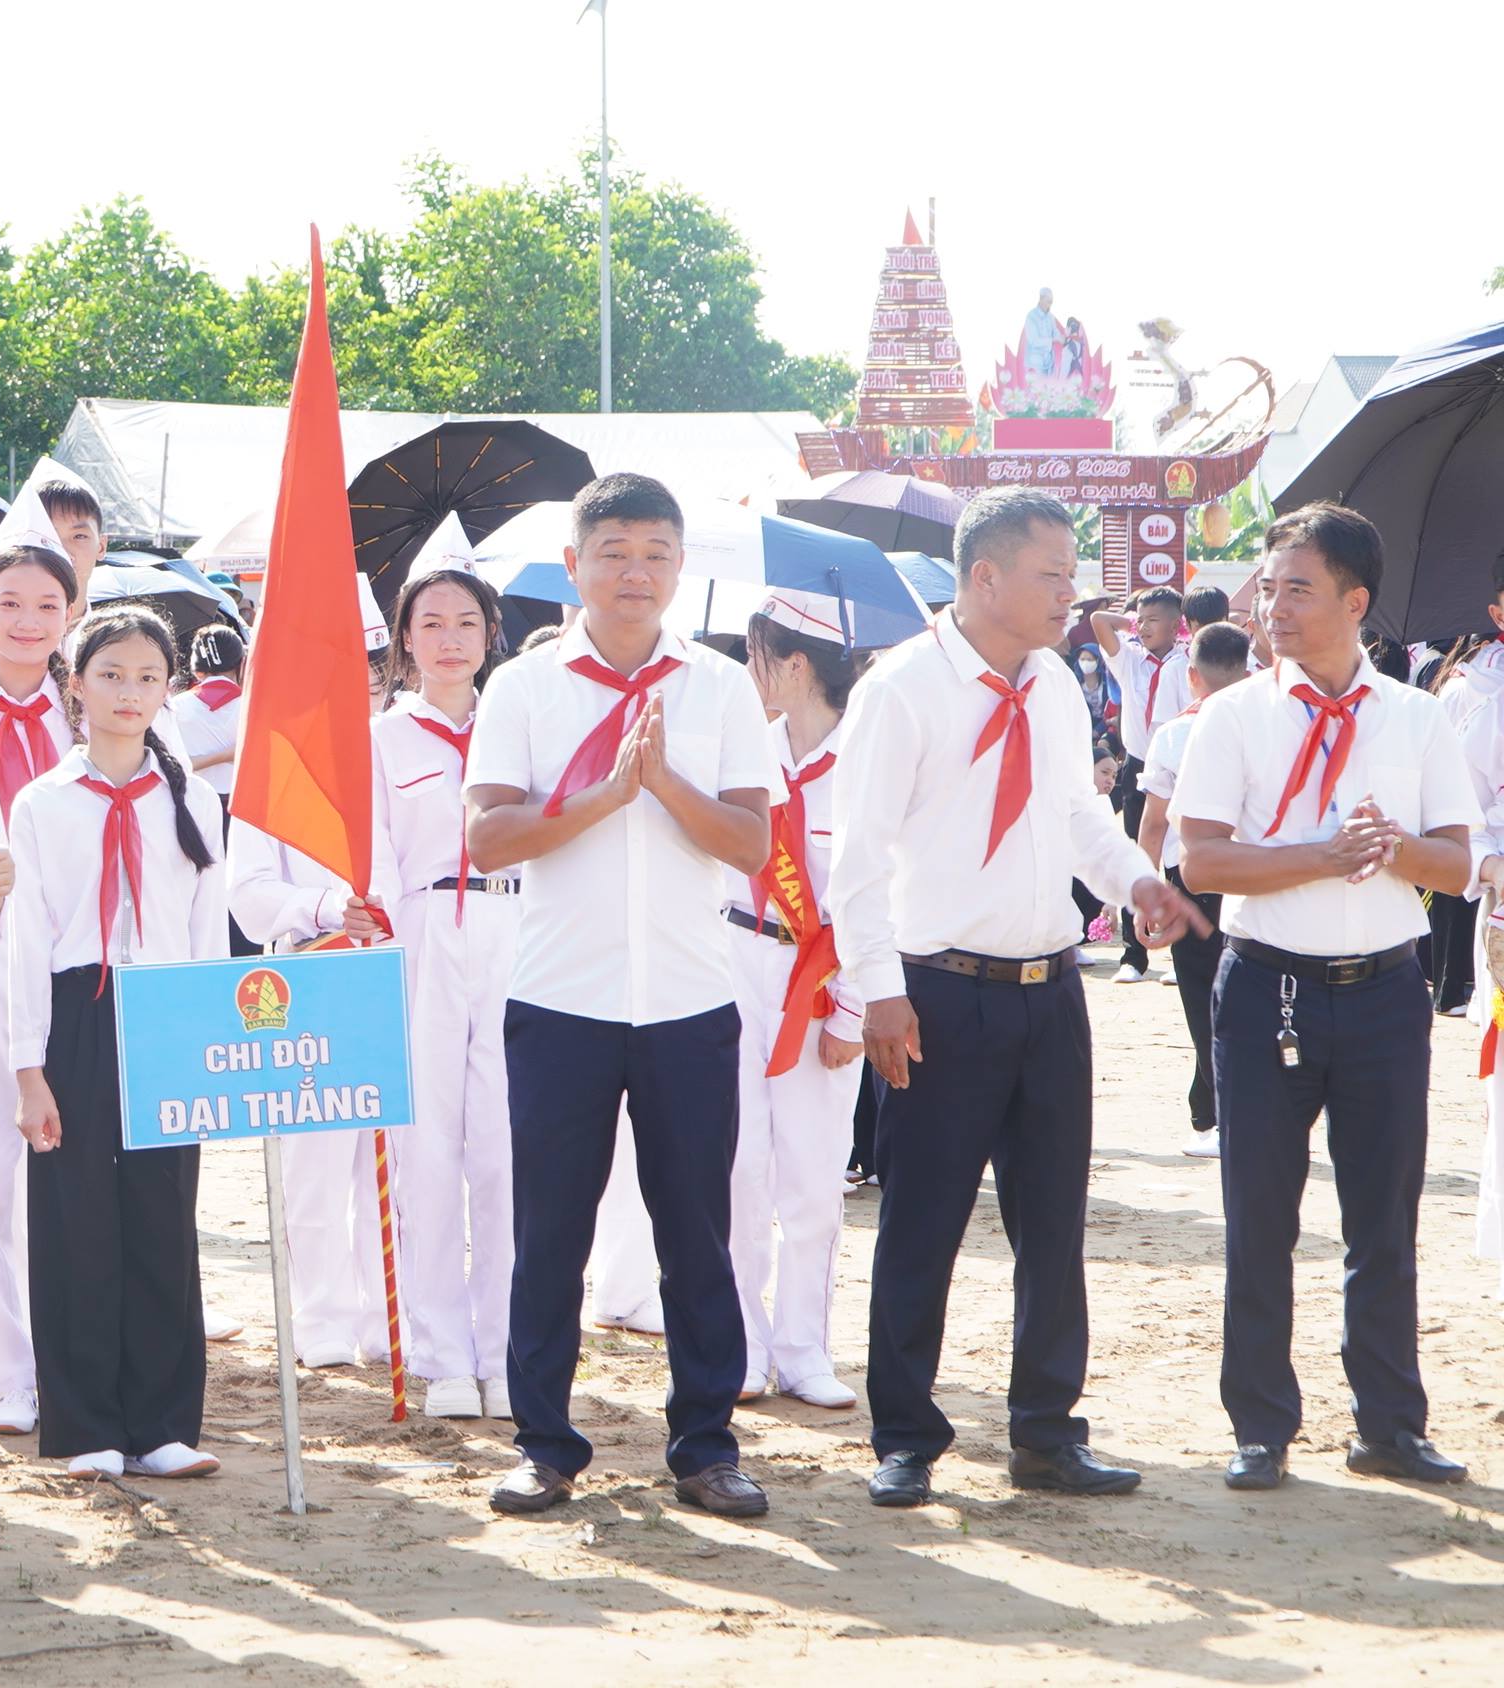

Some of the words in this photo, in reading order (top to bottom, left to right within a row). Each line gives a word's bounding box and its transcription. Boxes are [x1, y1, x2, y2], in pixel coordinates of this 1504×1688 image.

[1077, 460, 1131, 477] 2026
[1082, 486, 1118, 501] ĐẠI
[1121, 482, 1156, 499] HẢI
[204, 1040, 263, 1074] CHI
[271, 1031, 331, 1073] ĐỘI
[158, 1094, 231, 1140] ĐẠI
[242, 1074, 381, 1129] THẮNG
